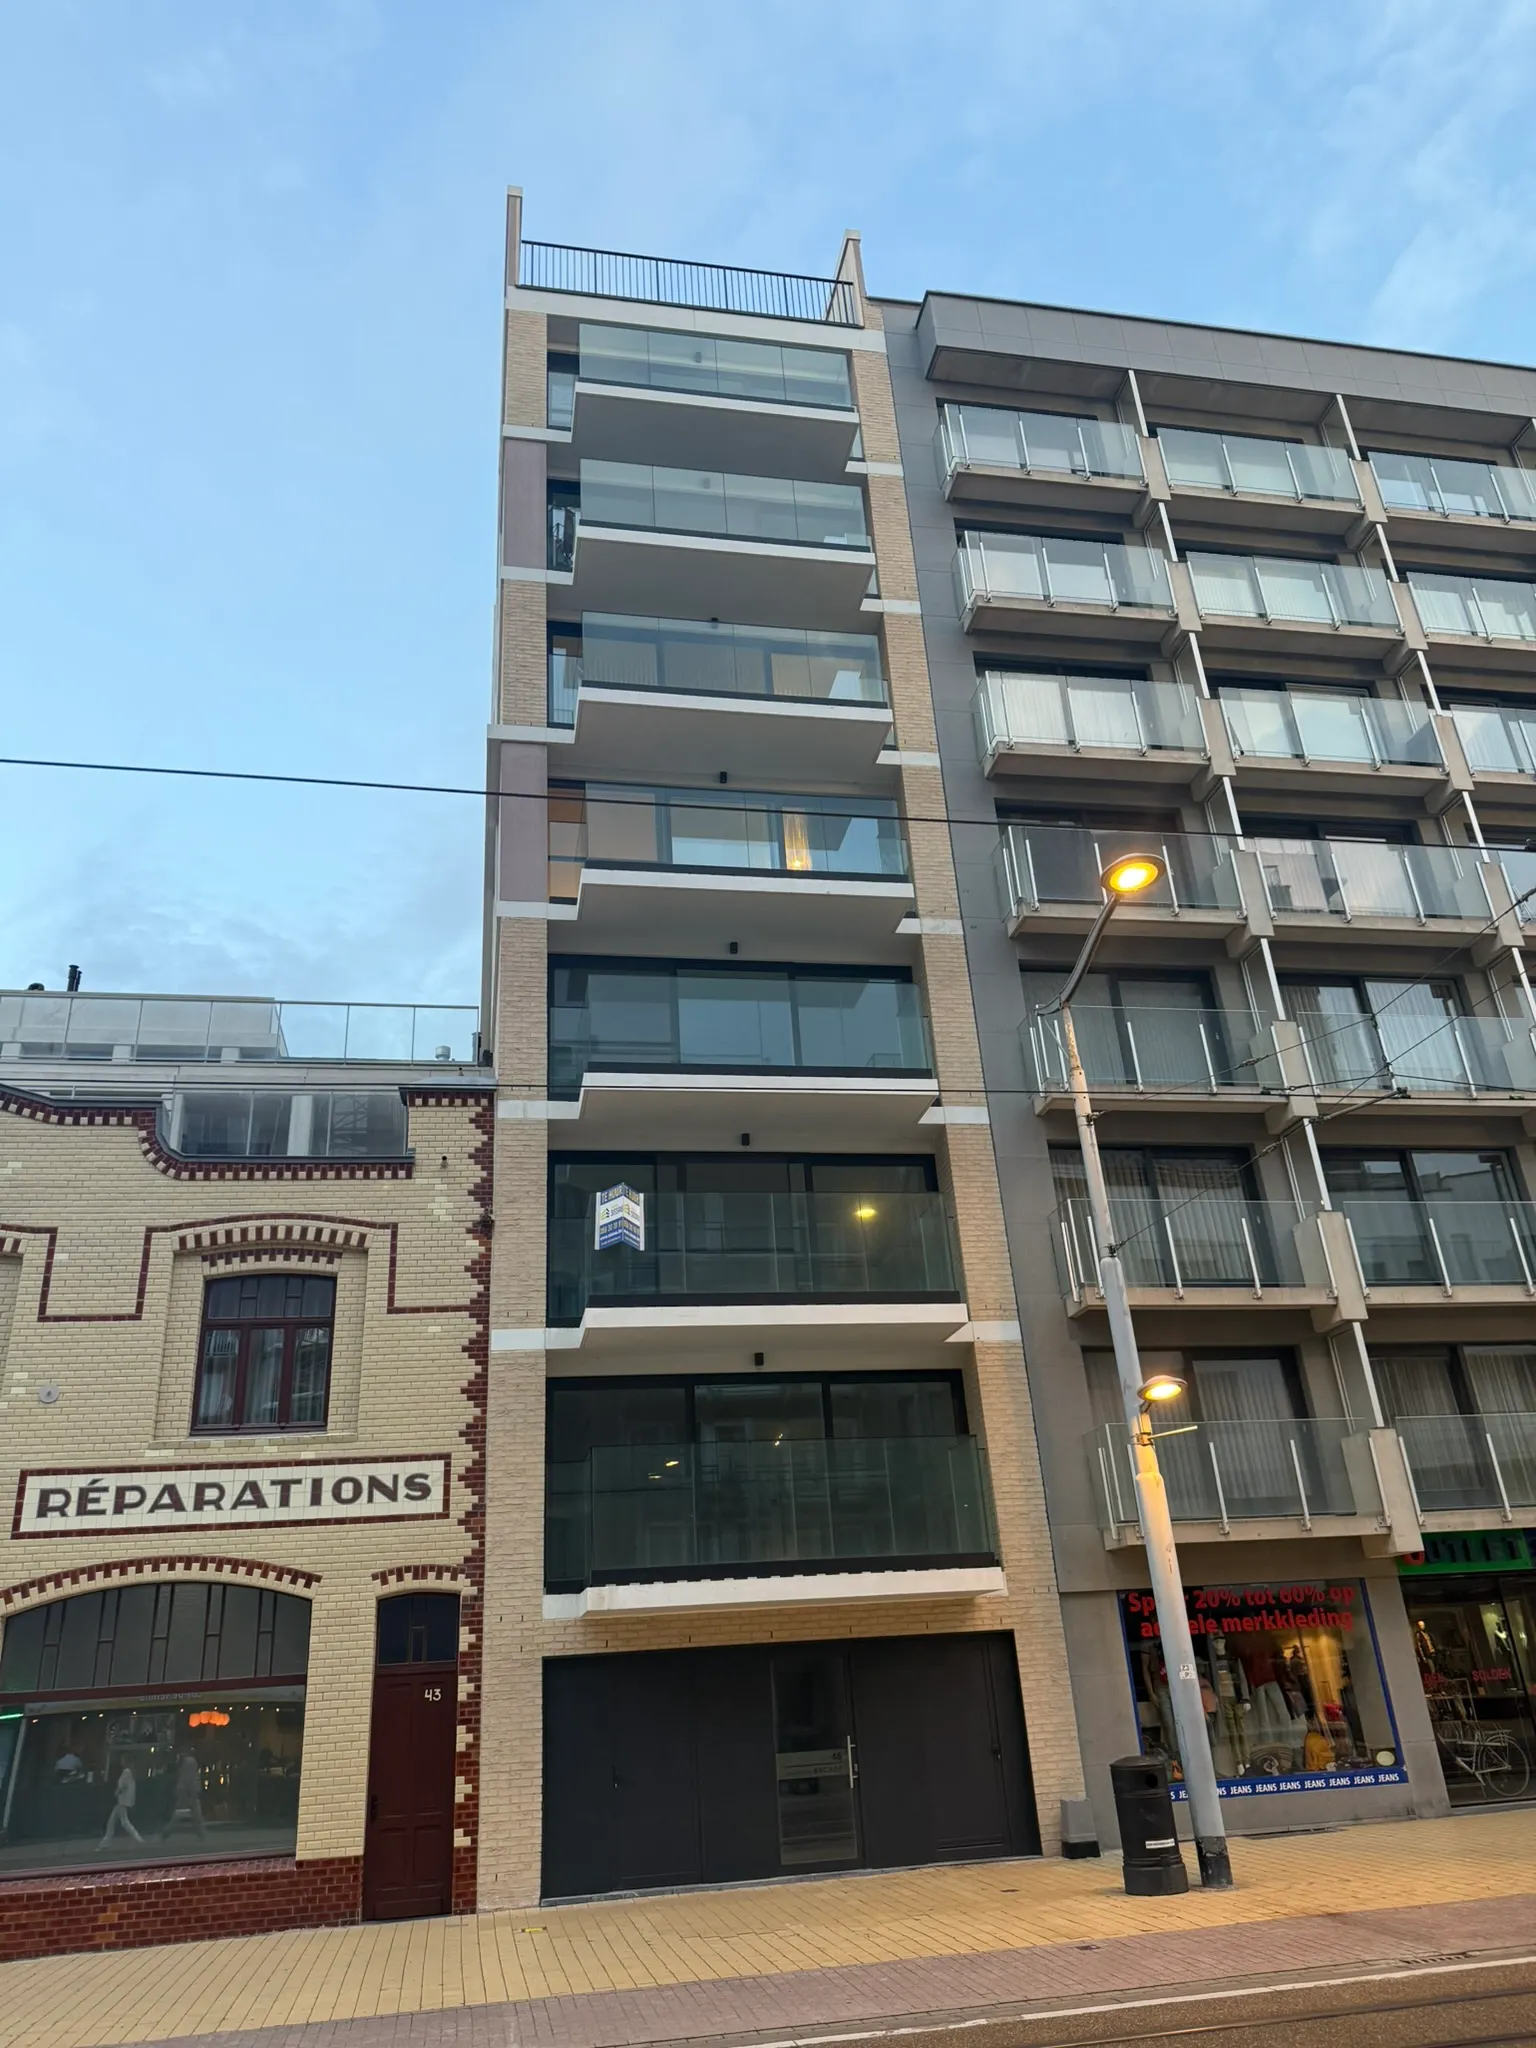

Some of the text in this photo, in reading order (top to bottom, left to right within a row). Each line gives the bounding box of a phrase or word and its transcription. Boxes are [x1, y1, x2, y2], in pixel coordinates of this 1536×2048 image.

[36, 1472, 432, 1518] RÉPARATIONS
[1193, 1586, 1240, 1609] 20%
[1243, 1584, 1275, 1606] tot
[1279, 1583, 1325, 1604] 60%
[1331, 1586, 1355, 1609] op
[1222, 1607, 1354, 1633] merkkleding
[1472, 1667, 1511, 1681] SOLDEN
[424, 1688, 442, 1701] 43
[1230, 1785, 1253, 1795] JEANS
[1255, 1783, 1278, 1793] JEANS
[1279, 1781, 1301, 1791] JEANS
[1304, 1779, 1326, 1789] JEANS
[1329, 1777, 1351, 1787] JEANS
[1354, 1775, 1376, 1785] JEANS
[1378, 1773, 1400, 1782] JEANS
